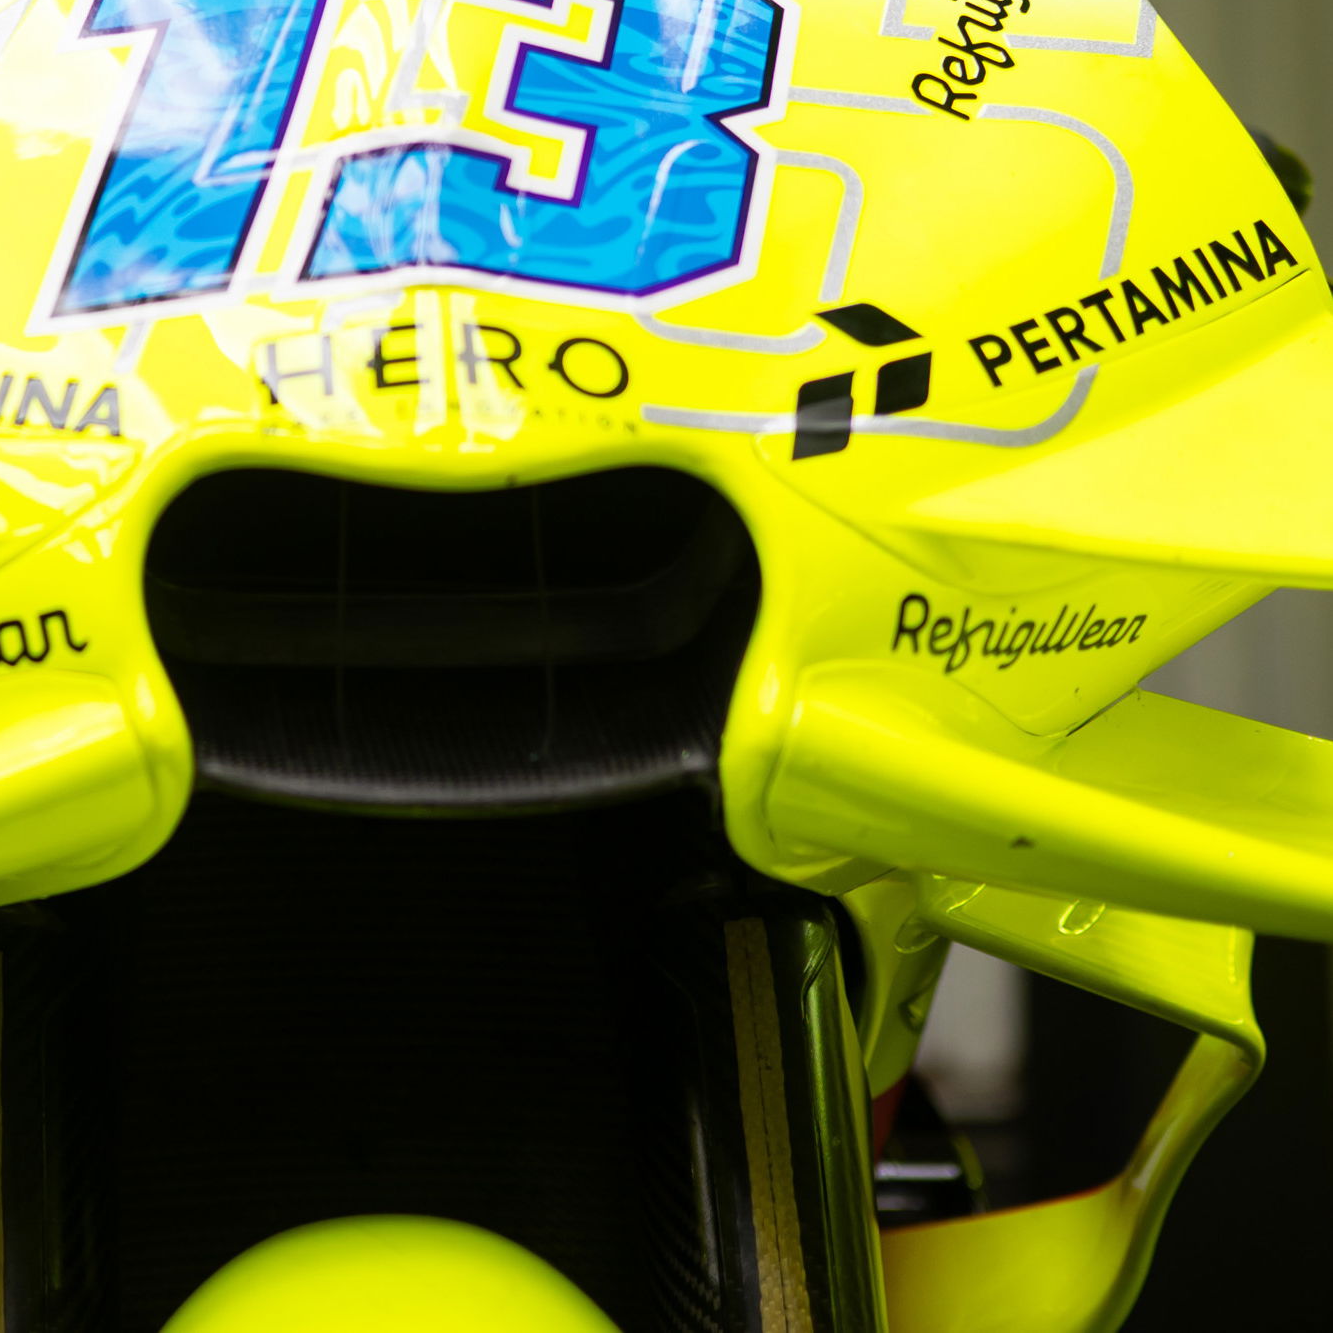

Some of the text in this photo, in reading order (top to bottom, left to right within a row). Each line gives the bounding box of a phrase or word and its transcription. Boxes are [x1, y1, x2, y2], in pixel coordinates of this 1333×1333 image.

[967, 219, 1298, 387] PERTAMINA
[260, 323, 630, 405] HERO
[891, 593, 1148, 674] RefrigiWear
